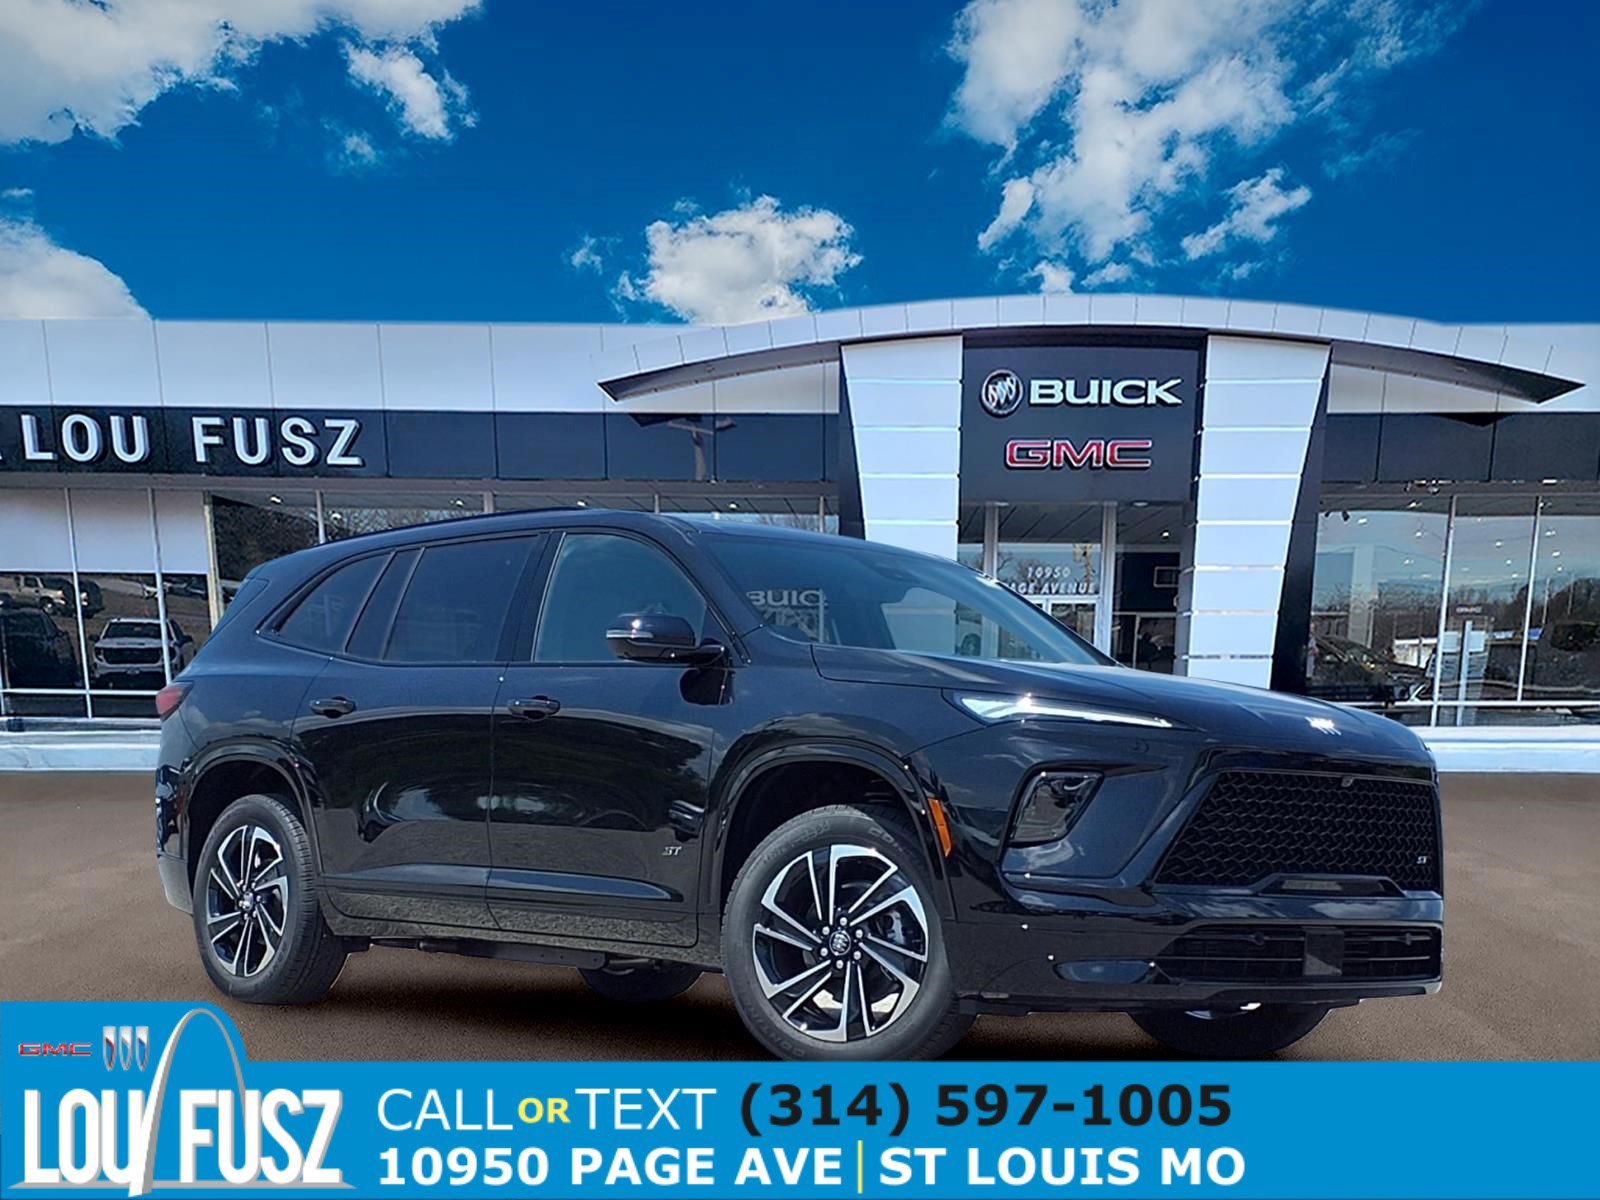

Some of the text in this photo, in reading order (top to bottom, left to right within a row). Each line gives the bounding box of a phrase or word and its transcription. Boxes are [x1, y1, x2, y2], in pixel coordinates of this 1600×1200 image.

[1029, 378, 1183, 404] BUICK
[20, 413, 364, 467] LOU FUSZ
[1005, 439, 1152, 467] GMC
[1027, 566, 1071, 579] 10950
[1007, 582, 1096, 594] AGE AVENUE
